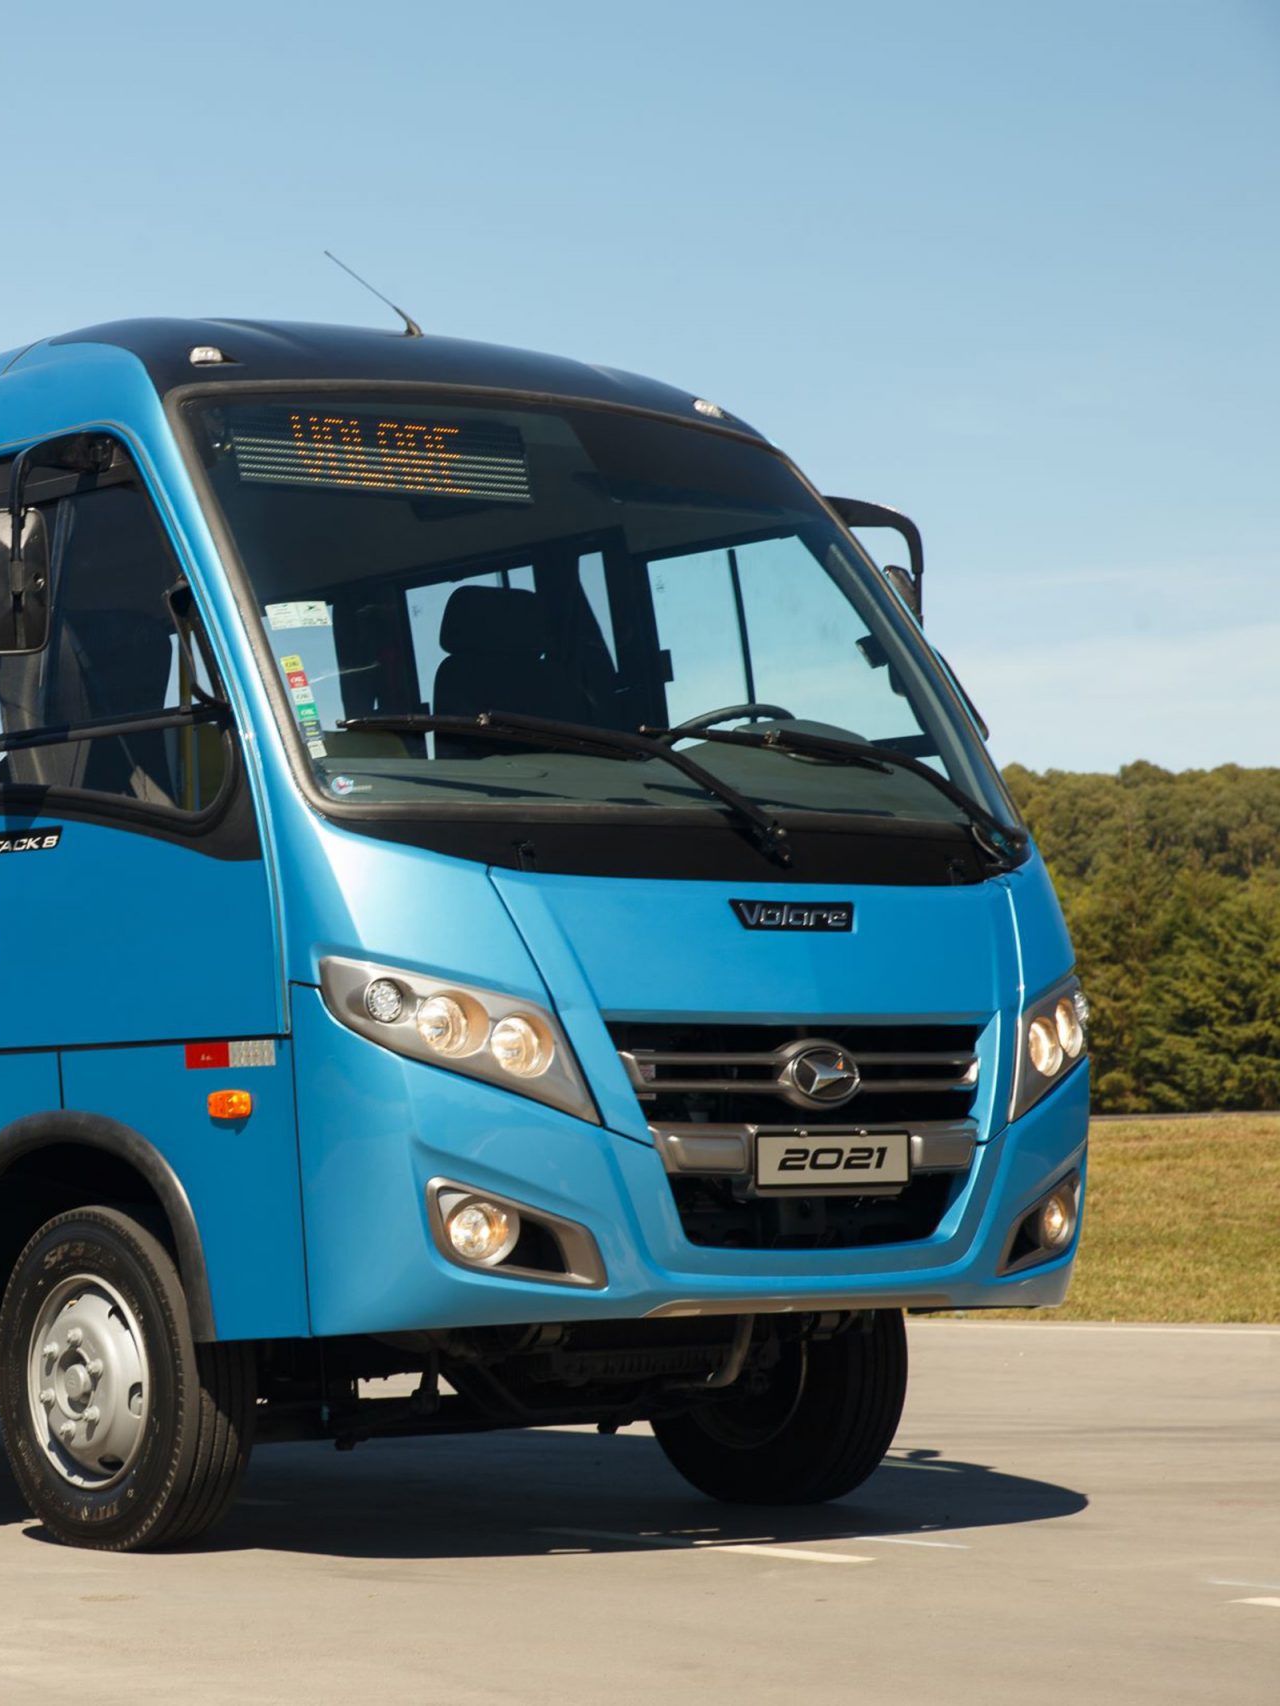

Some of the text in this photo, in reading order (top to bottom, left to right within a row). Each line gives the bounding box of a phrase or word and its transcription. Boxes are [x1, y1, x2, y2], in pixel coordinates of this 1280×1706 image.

[42, 835, 59, 848] 8
[738, 902, 848, 926] Volare
[777, 1146, 888, 1171] 2021
